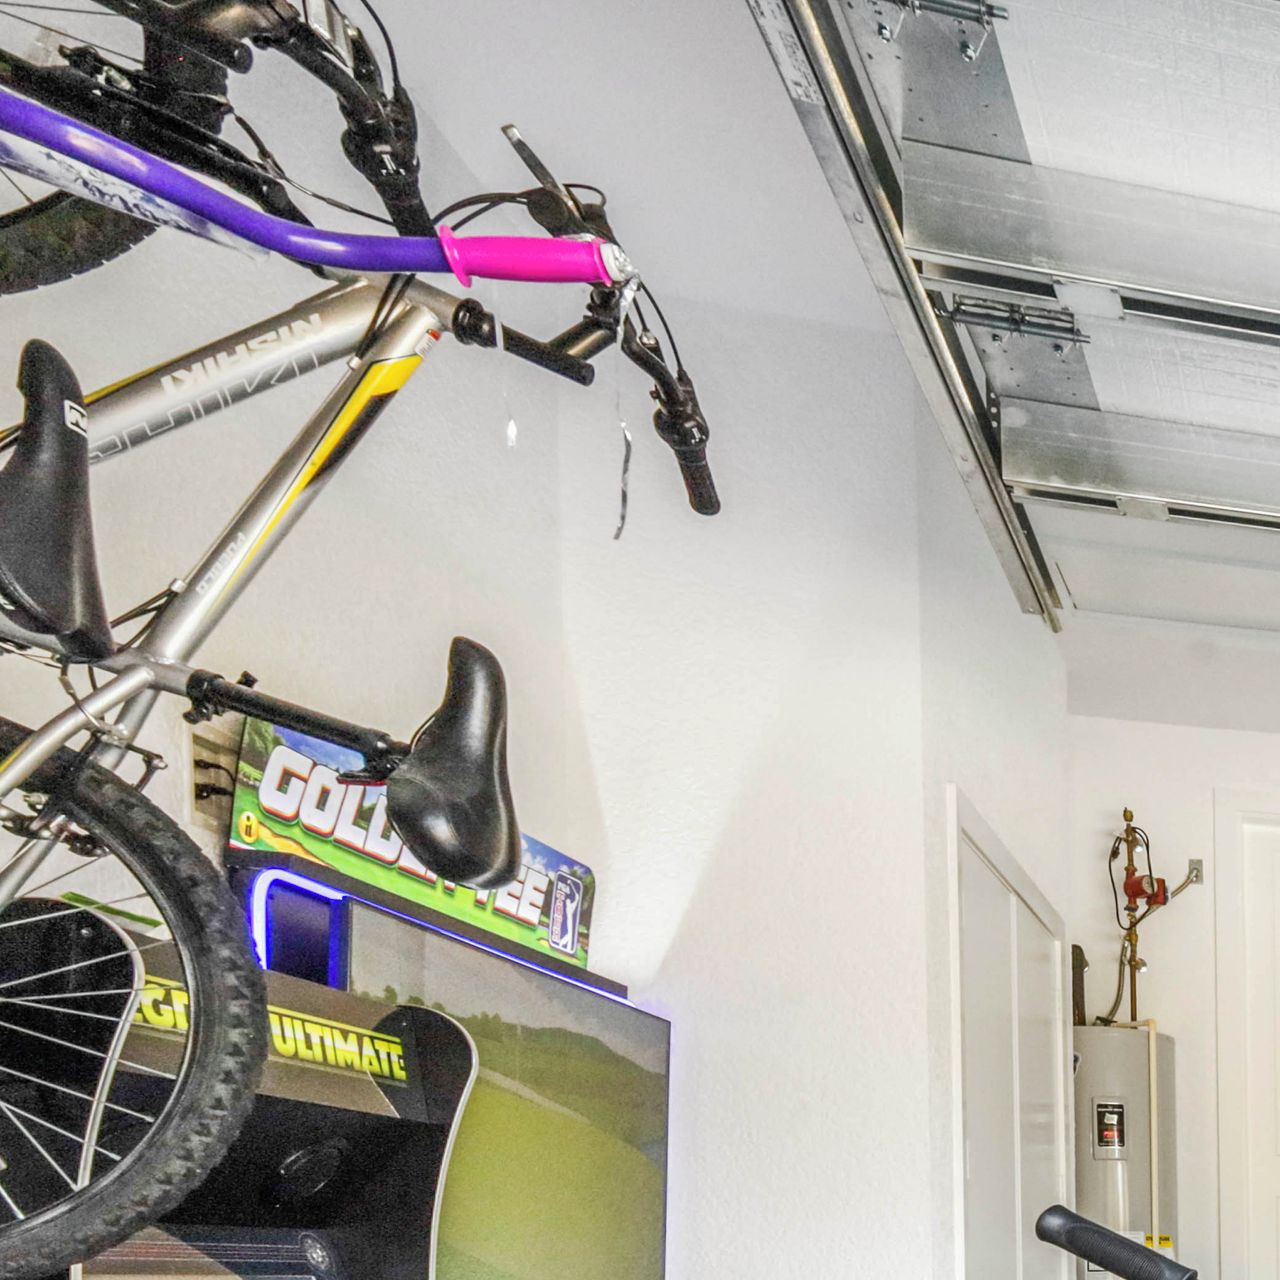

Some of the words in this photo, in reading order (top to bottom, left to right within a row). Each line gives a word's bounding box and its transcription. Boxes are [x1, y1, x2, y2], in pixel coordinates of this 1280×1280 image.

[160, 311, 323, 396] NISHIKI
[258, 744, 454, 895] GOLD
[268, 1012, 407, 1081] ULTIMATE
